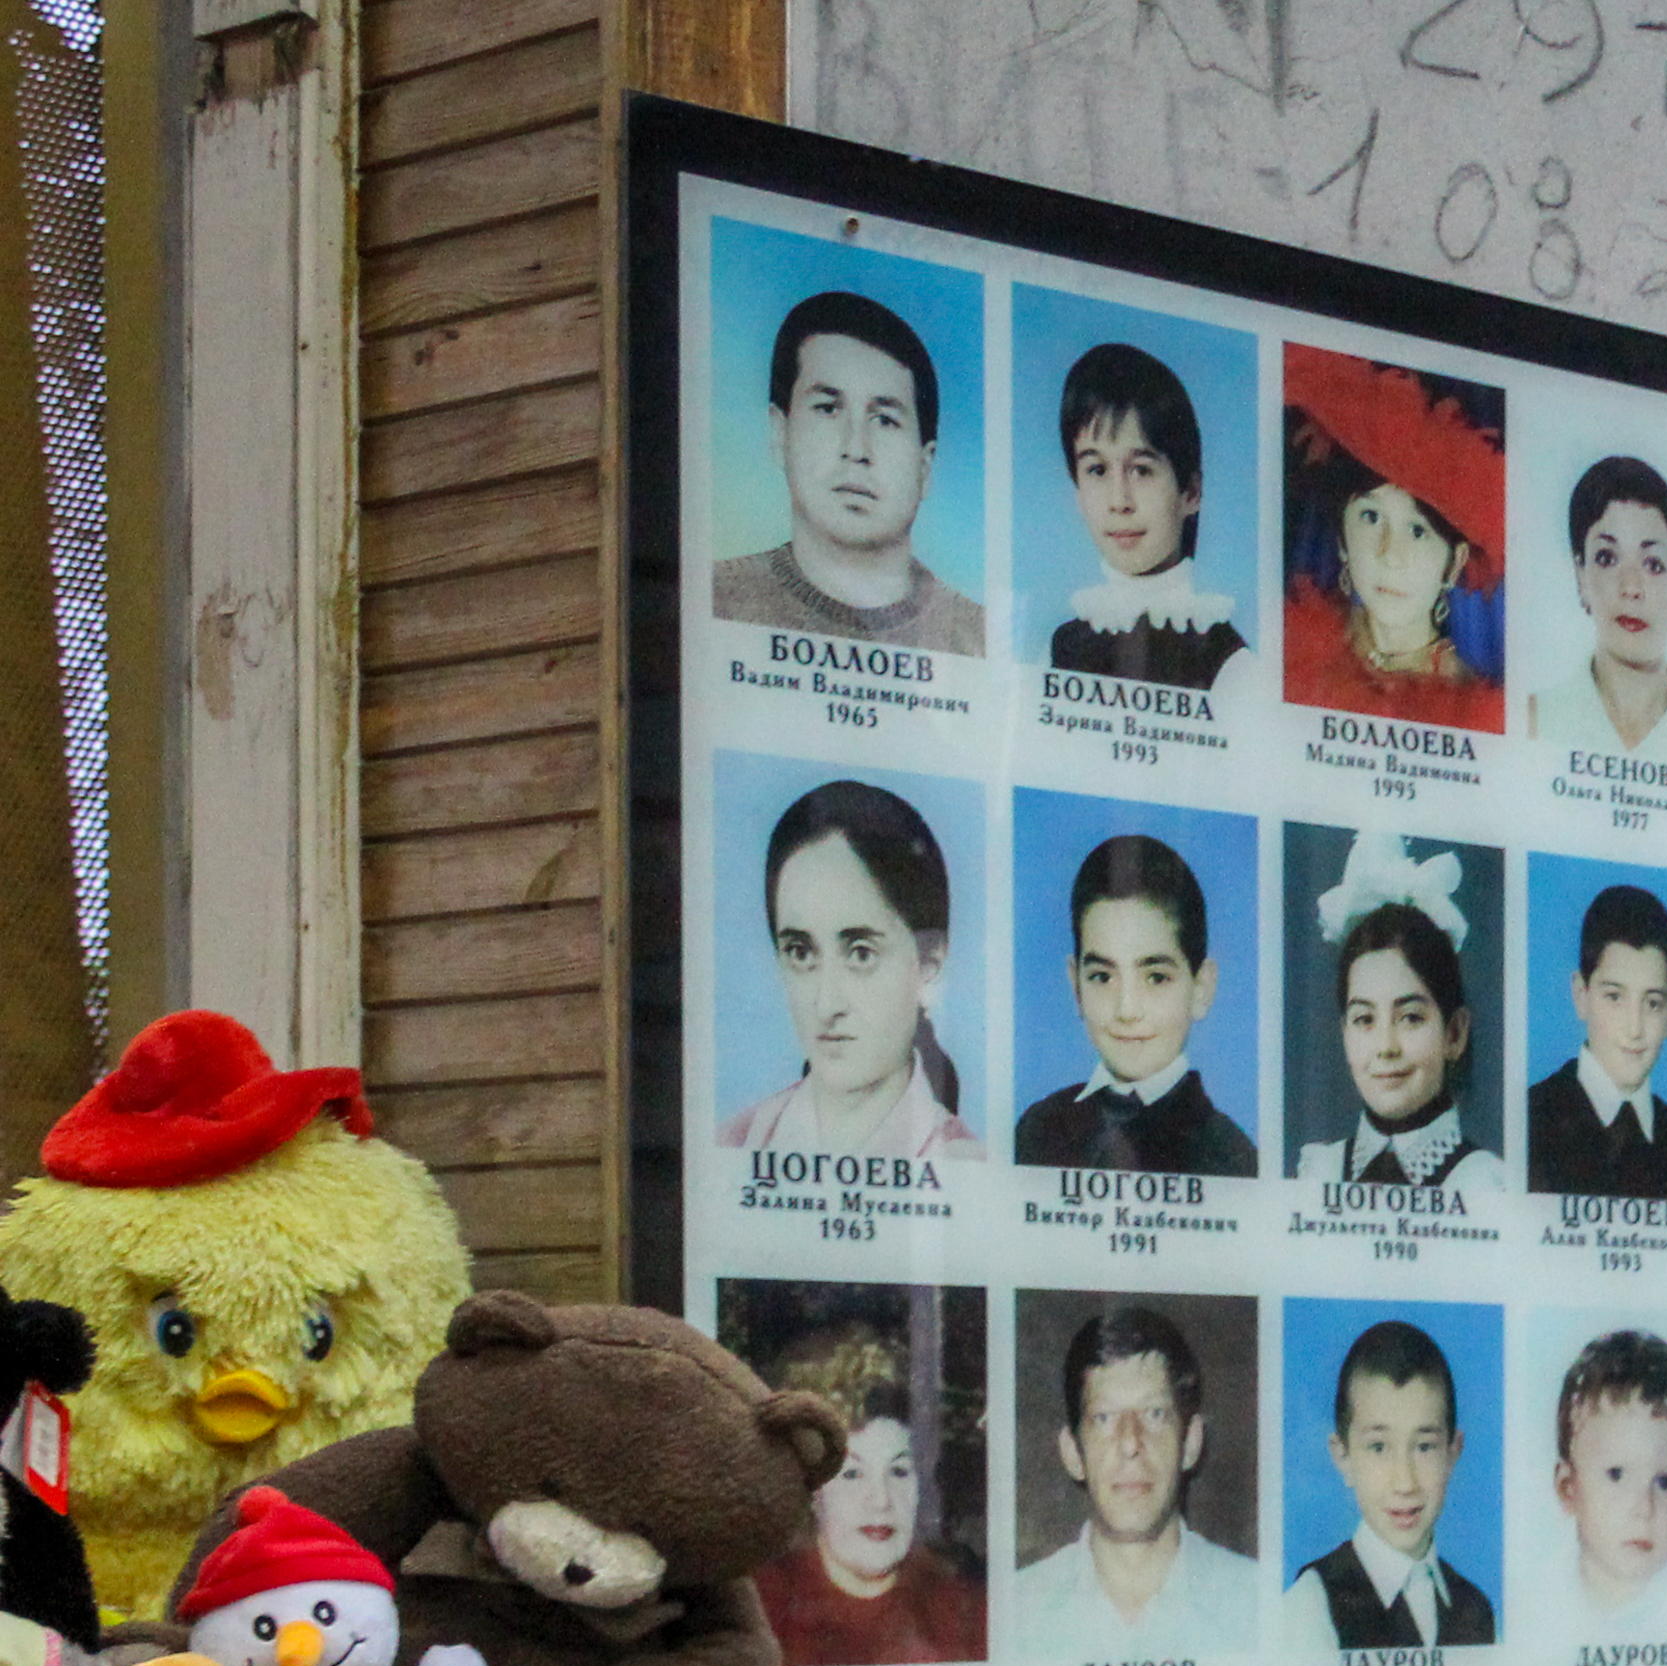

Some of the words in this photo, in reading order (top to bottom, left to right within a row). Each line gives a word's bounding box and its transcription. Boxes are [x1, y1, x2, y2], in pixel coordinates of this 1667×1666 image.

[769, 633, 934, 682] БОЛЛОЕВ
[730, 661, 800, 689] Вадим
[812, 673, 969, 713] Владимирович
[1043, 673, 1214, 720] БОЛЛОЕВА
[826, 702, 879, 727] 1965
[1038, 705, 1114, 735] Зарина
[1123, 717, 1228, 748] Вадимовна
[1111, 739, 1158, 763] 1993
[1321, 716, 1477, 761] БОЛЛОЕВА
[1305, 743, 1377, 770] Мадина
[1386, 754, 1481, 785] Вадимовна
[1373, 778, 1416, 798] 1995
[1612, 810, 1648, 829] 1977
[752, 1150, 940, 1190] ЦОГОЕВА
[740, 1185, 828, 1213] Залина
[841, 1192, 952, 1218] Мусаевна
[1060, 1169, 1203, 1205] ЦОГОЕВ
[1322, 1183, 1467, 1216] ЦОГОЕВА
[819, 1218, 875, 1241] 1963
[1025, 1202, 1103, 1229] Виктор
[1114, 1207, 1238, 1233] Казбекович
[1108, 1233, 1158, 1254] 1991
[1373, 1241, 1417, 1261] 1990
[1600, 1252, 1642, 1273] 1993
